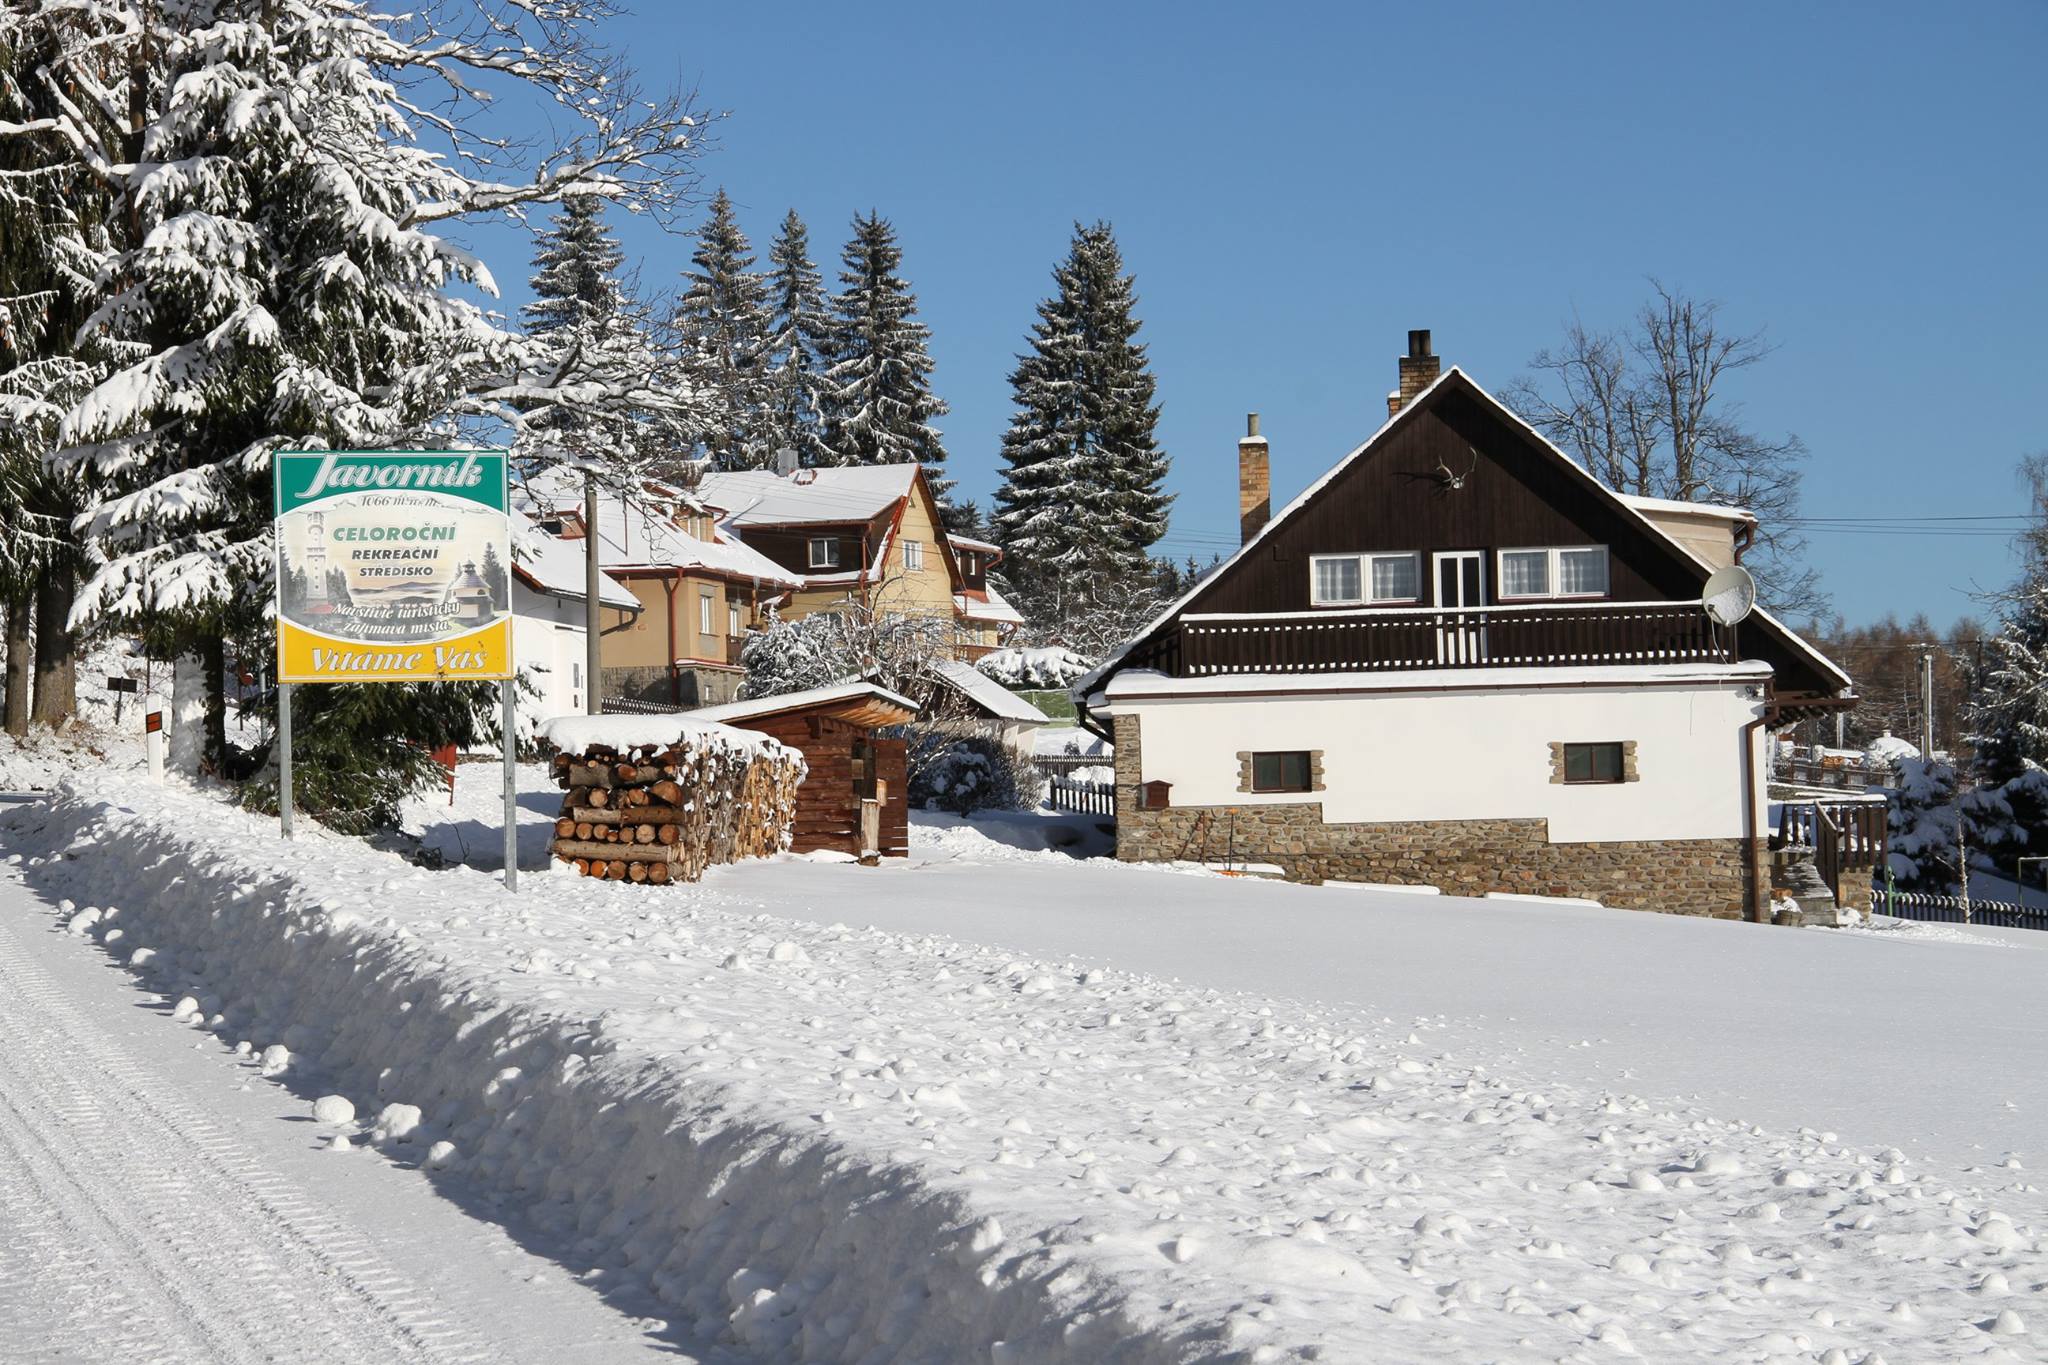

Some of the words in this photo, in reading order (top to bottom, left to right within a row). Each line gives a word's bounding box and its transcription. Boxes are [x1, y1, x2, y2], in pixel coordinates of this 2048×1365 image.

[361, 494, 391, 506] 1066
[333, 522, 456, 541] CELOROČNÍ
[351, 546, 439, 560] REKREAČNÍ
[360, 563, 433, 577] STŘEDISKO
